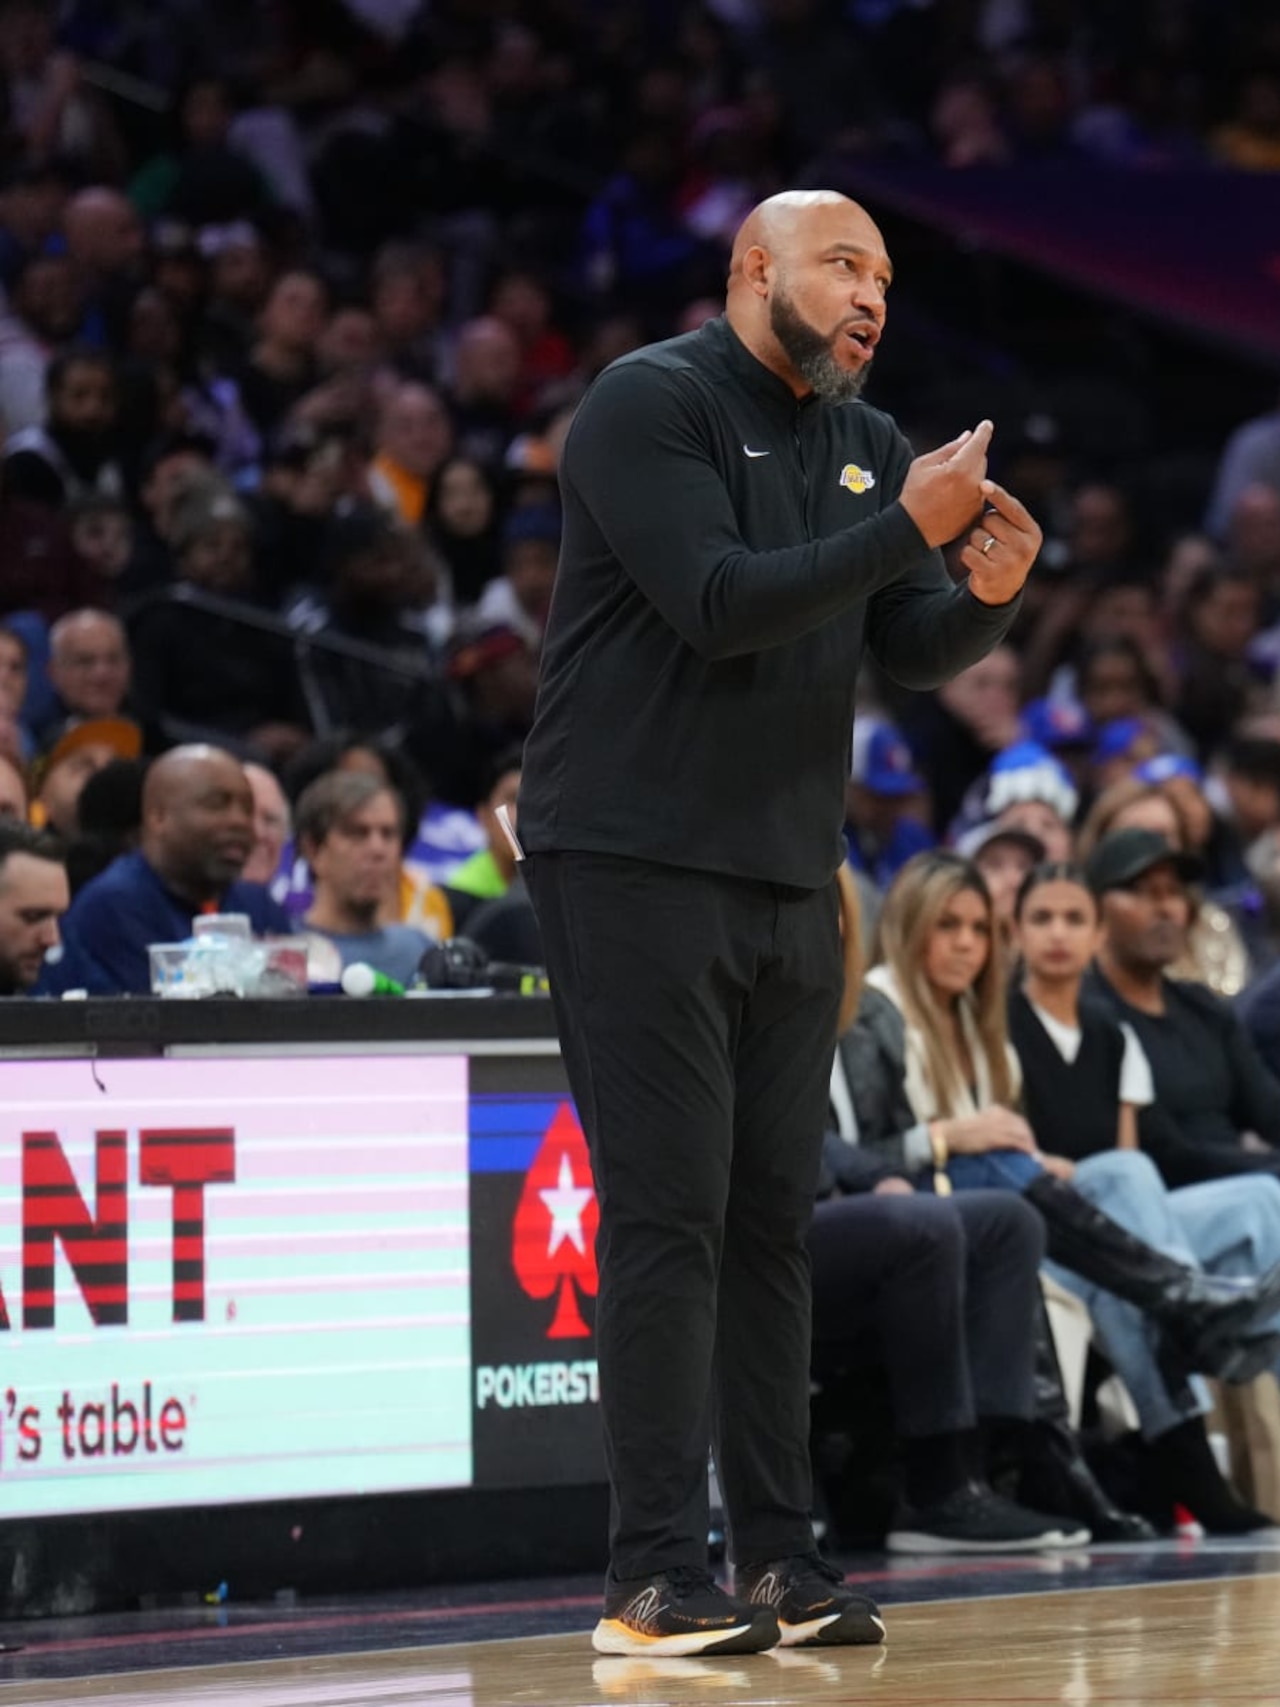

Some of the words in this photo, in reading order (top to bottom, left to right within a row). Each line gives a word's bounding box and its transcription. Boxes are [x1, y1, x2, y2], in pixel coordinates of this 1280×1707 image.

[0, 1127, 235, 1331] NT
[0, 1386, 41, 1464] 's
[57, 1379, 187, 1460] table
